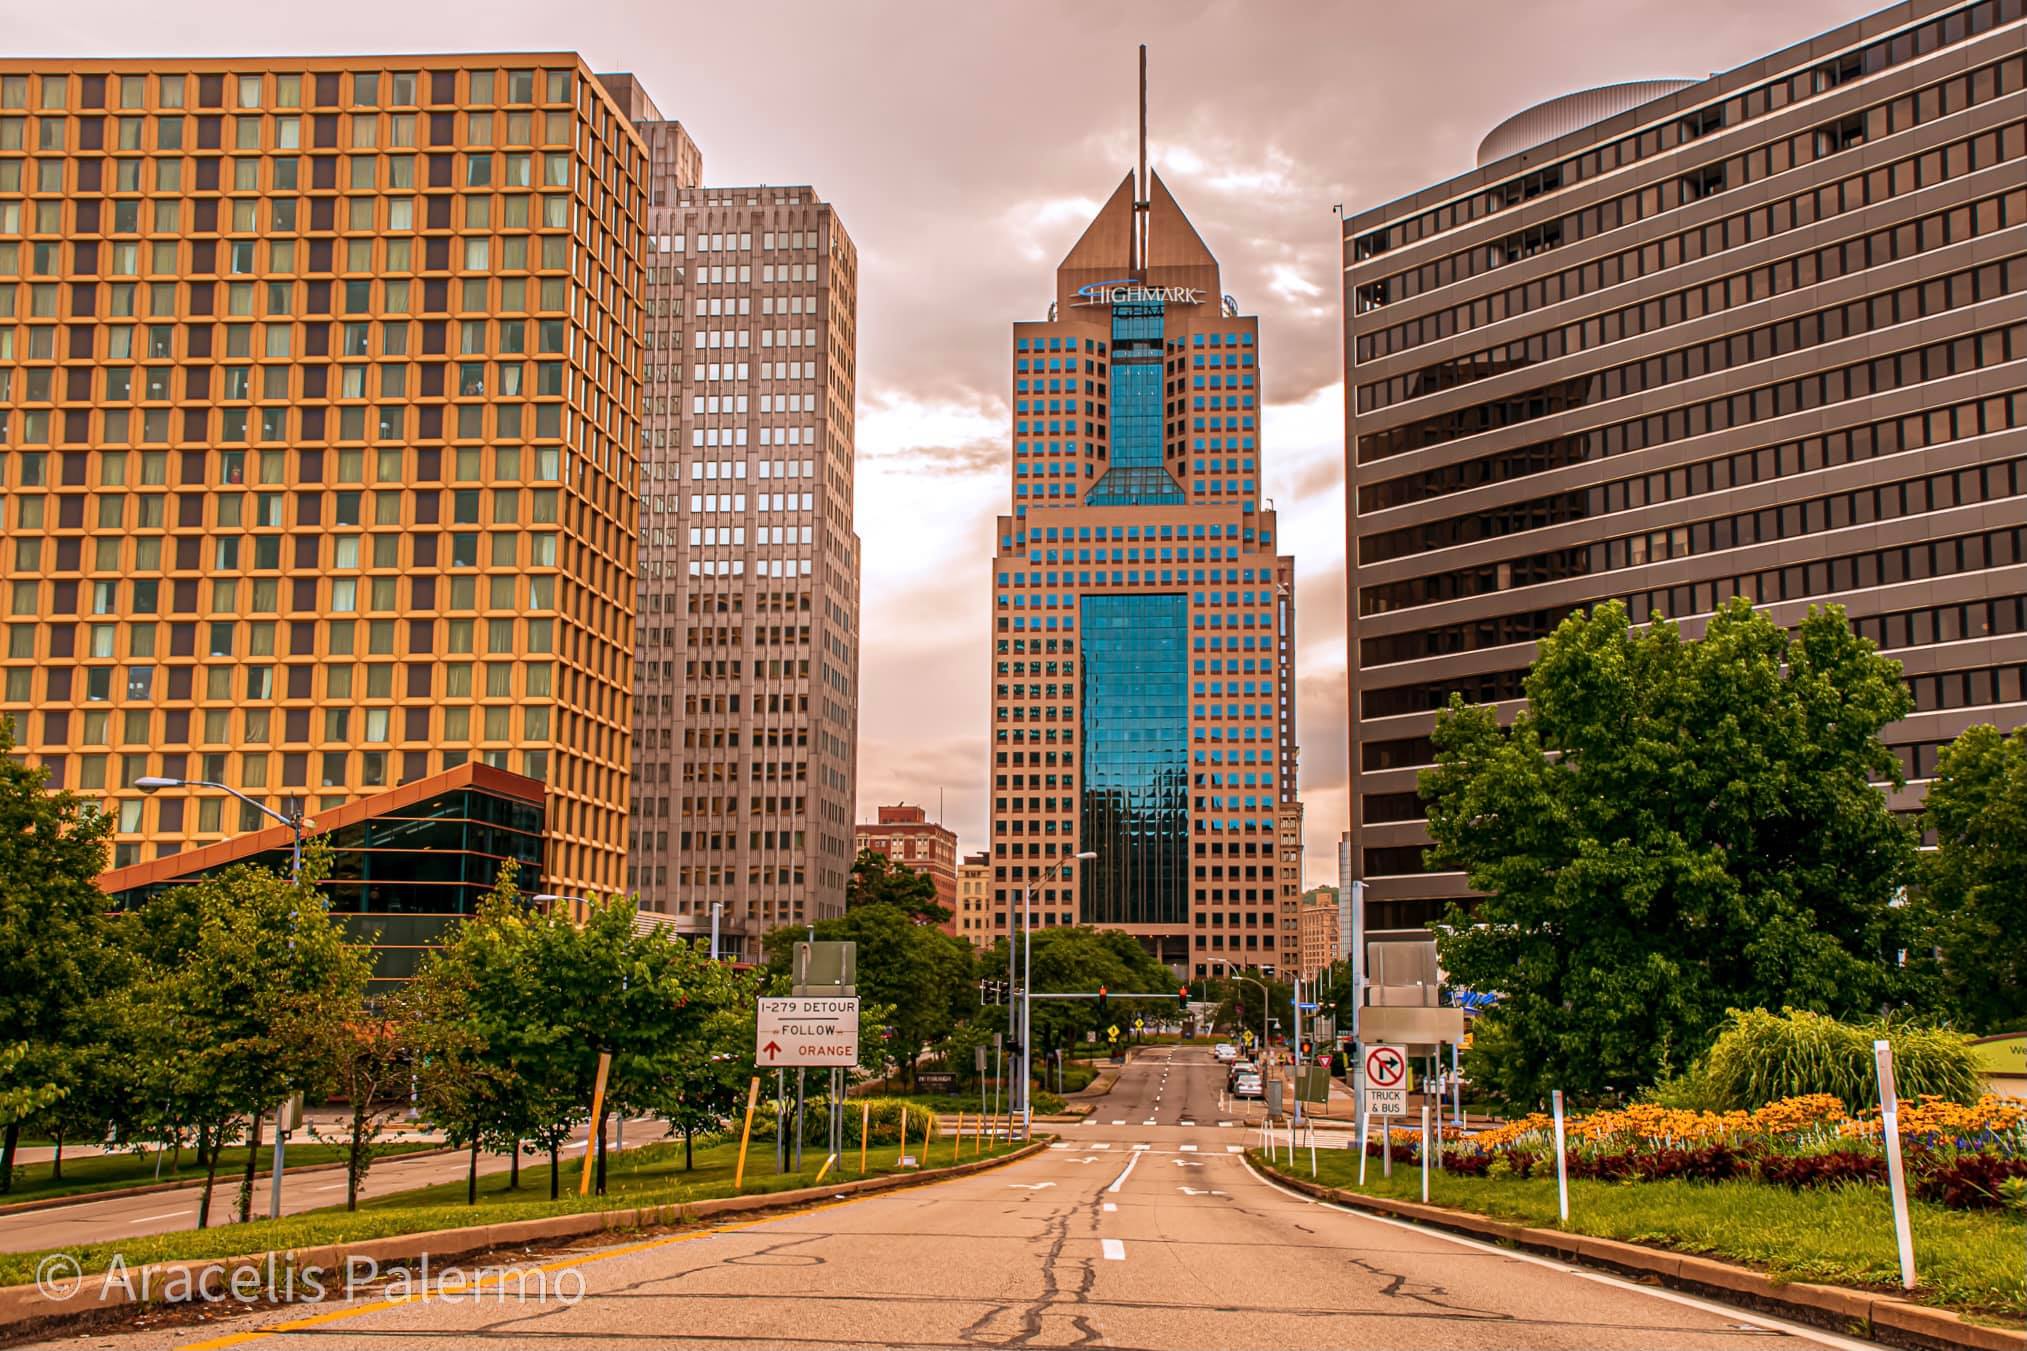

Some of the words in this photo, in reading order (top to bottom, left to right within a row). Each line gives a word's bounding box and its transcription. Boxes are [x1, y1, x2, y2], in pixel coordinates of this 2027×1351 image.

[1090, 286, 1198, 304] HIGHMARK
[761, 1002, 797, 1012] I-279
[803, 1002, 855, 1012] DETOUR
[782, 1025, 835, 1035] FOLLOW
[799, 1046, 853, 1056] ORANGE
[1371, 1091, 1401, 1100] TRUCK
[1371, 1103, 1378, 1113] &
[1381, 1103, 1401, 1113] BUS
